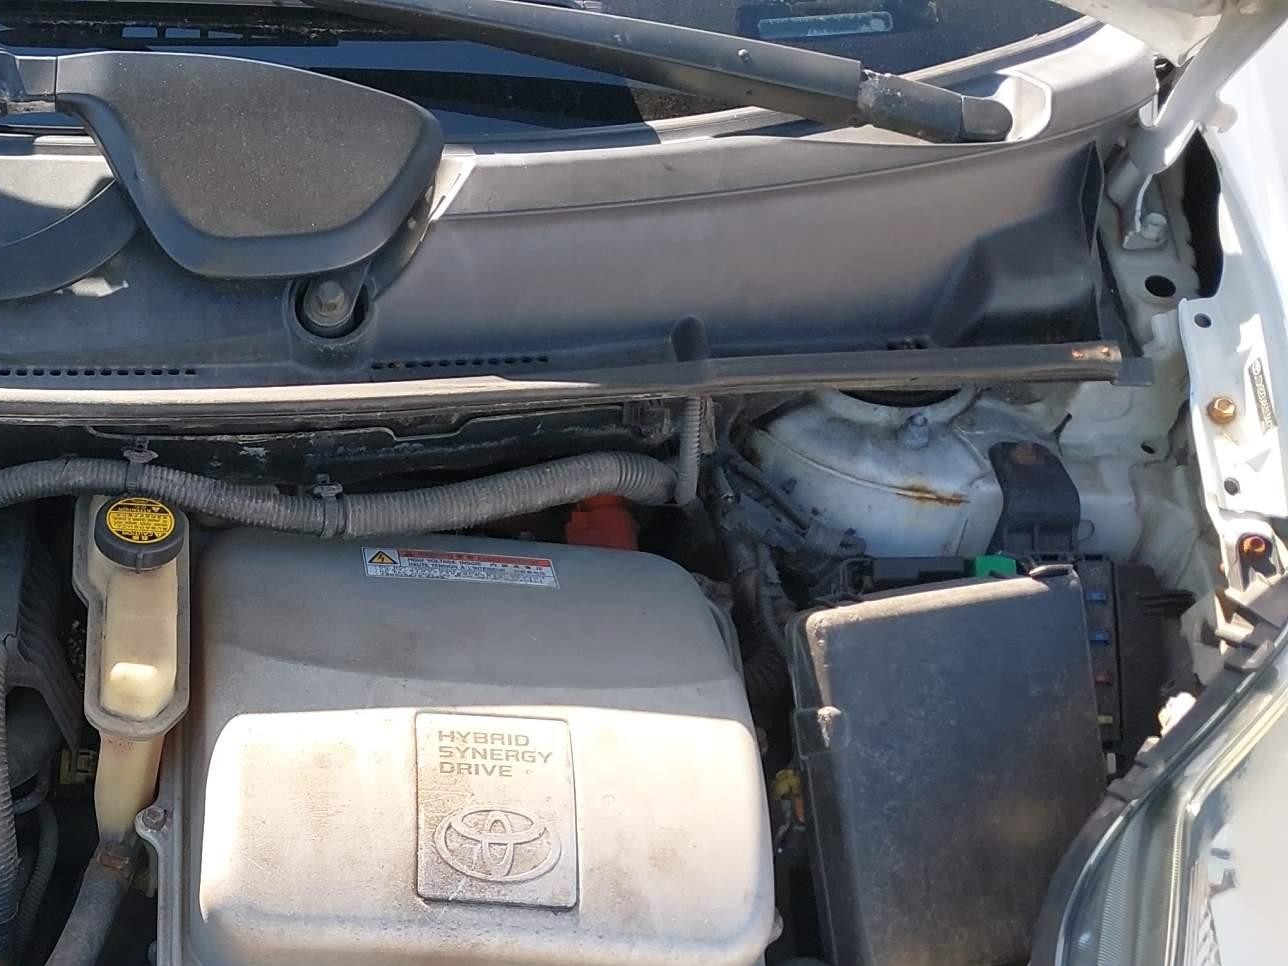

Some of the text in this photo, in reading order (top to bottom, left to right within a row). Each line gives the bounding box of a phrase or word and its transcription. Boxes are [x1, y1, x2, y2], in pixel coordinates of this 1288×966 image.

[438, 730, 530, 747] HYBRID
[439, 745, 553, 764] SYNERGY
[439, 761, 513, 777] DRIVE
